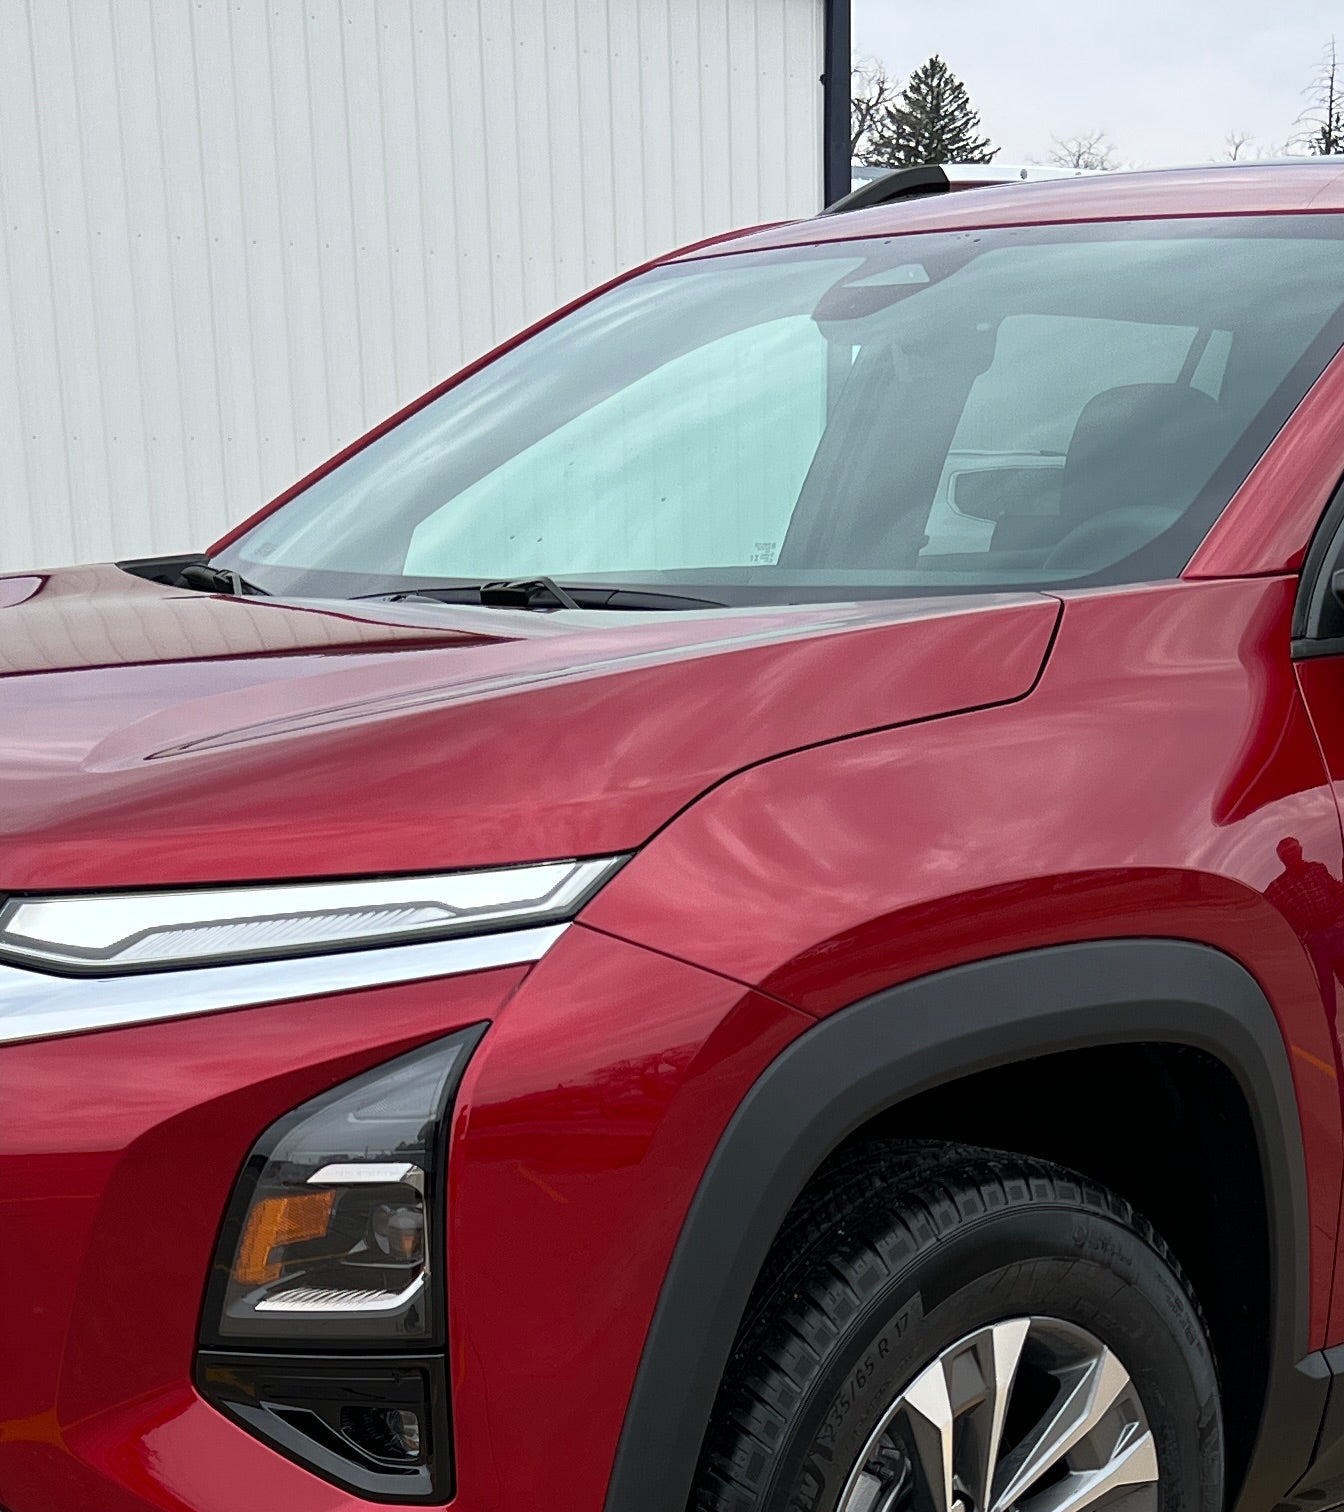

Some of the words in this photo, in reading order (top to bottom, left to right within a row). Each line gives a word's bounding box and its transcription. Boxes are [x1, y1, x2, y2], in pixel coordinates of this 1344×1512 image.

[816, 1356, 875, 1444] 235/65
[877, 1337, 889, 1359] R
[894, 1312, 909, 1339] 17
